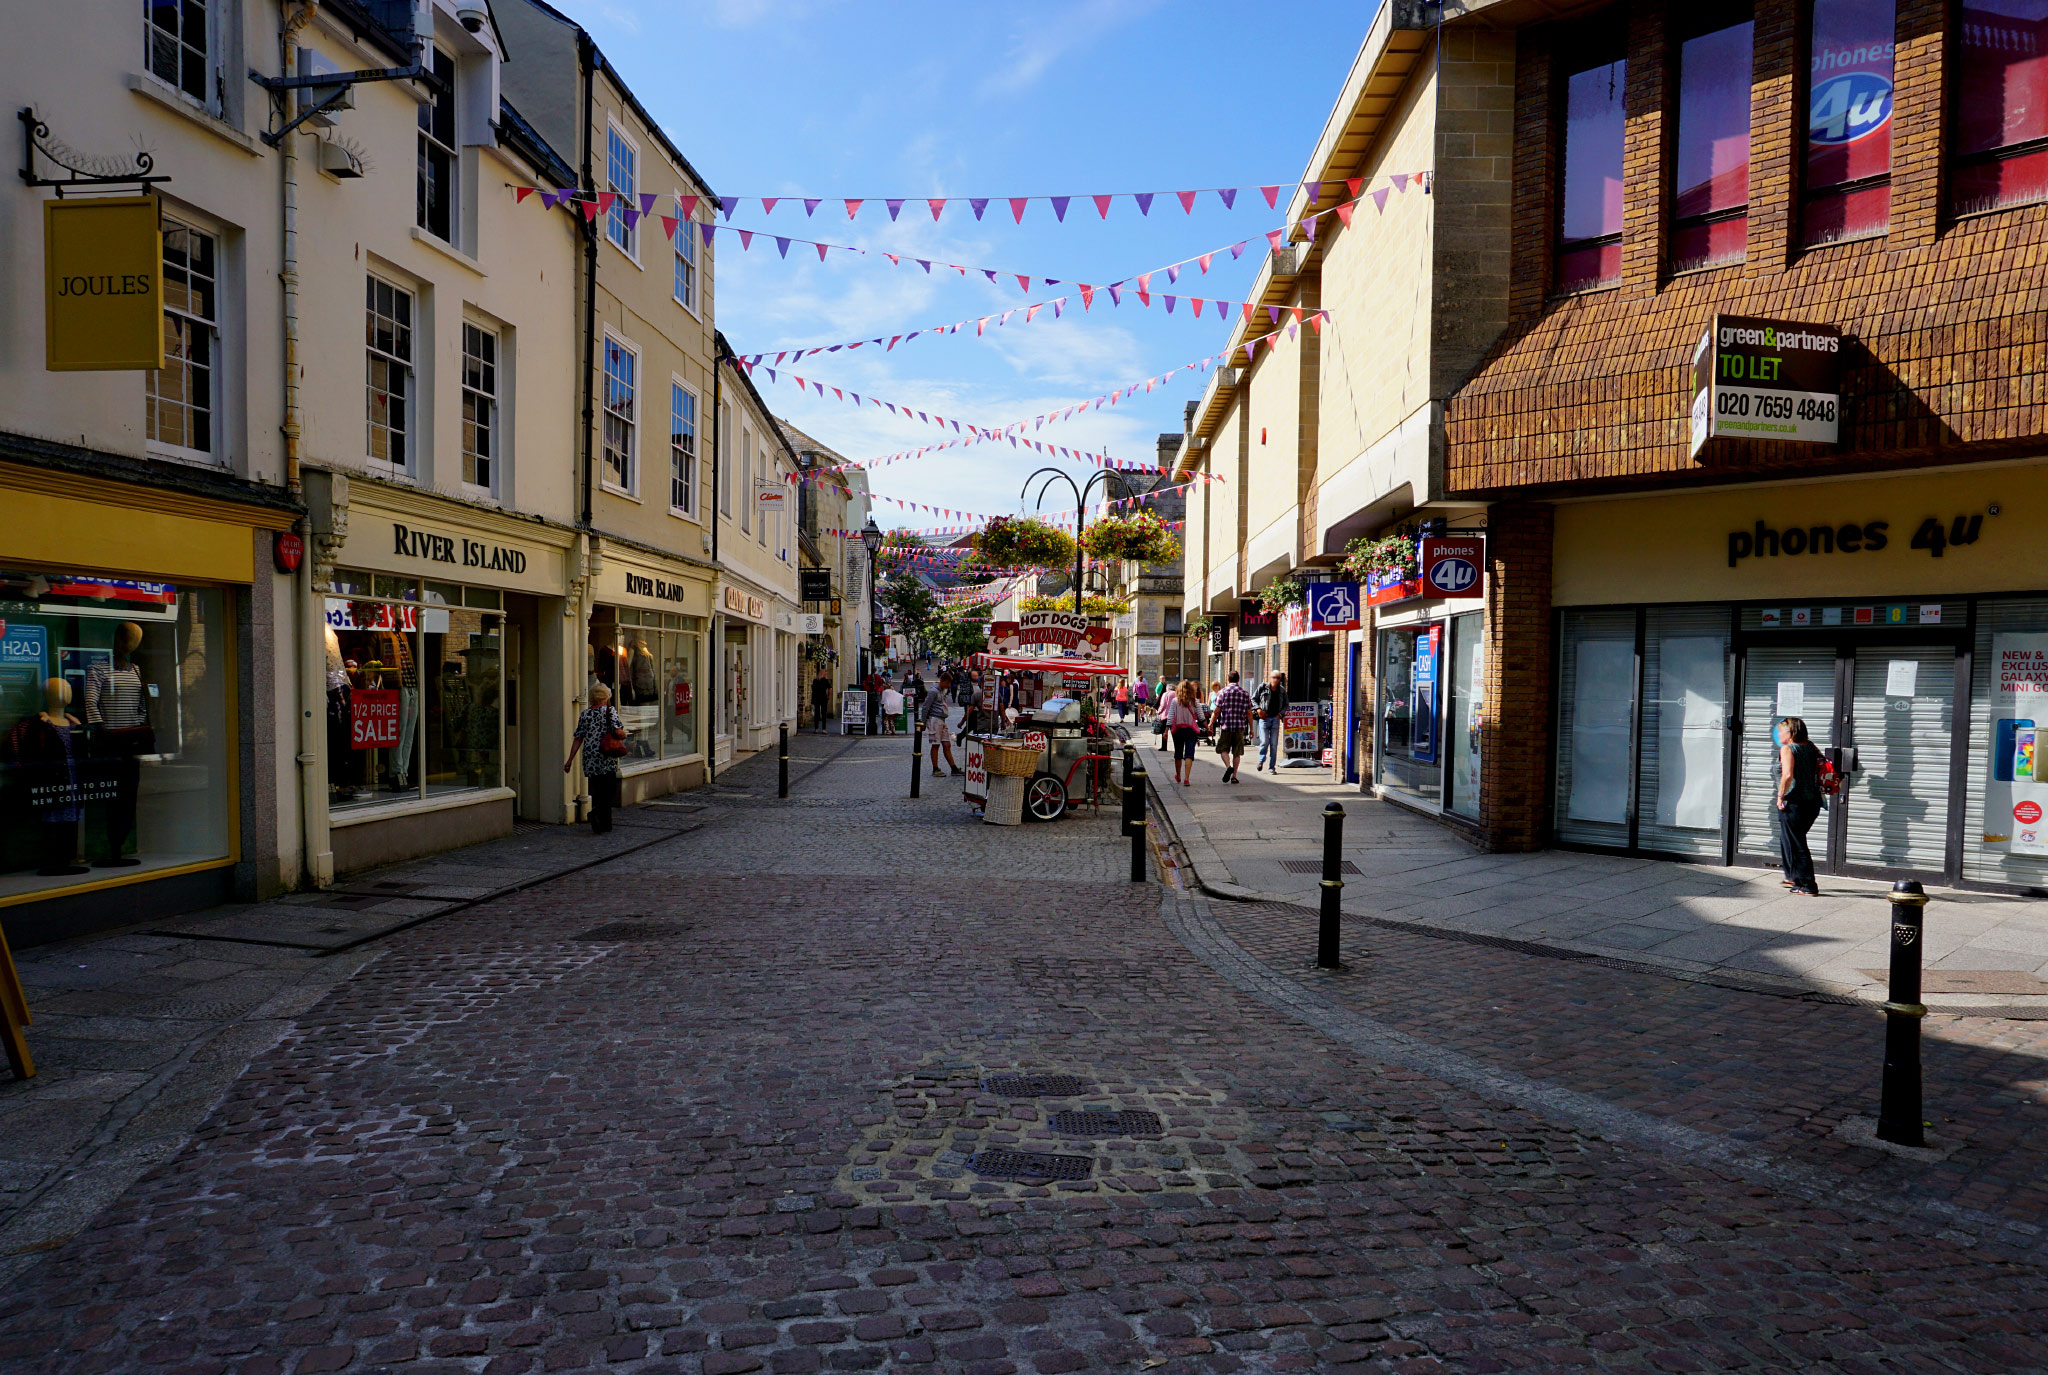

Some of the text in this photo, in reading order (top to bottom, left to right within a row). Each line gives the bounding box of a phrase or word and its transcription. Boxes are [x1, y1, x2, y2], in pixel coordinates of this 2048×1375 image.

[1810, 80, 1889, 139] 4u
[58, 274, 149, 296] JOULES
[1720, 326, 1839, 353] green&partners
[1719, 354, 1783, 381] TO LET
[1717, 392, 1750, 416] 020
[1754, 395, 1793, 419] 7659
[1796, 398, 1835, 422] 4848
[1717, 419, 1797, 433] greenandpartners.co.uk
[1728, 514, 1984, 568] phones 4u
[1433, 545, 1475, 558] phones
[1434, 560, 1473, 590] 4u
[1020, 613, 1087, 630] HOT DOGS
[1244, 611, 1273, 625] hmv
[1213, 625, 1223, 651] next
[1418, 654, 1432, 671] CASH
[2002, 650, 2045, 660] NEW &
[2001, 661, 2048, 671] EXCLUS
[2000, 683, 2029, 692] MINI
[353, 703, 397, 718] 1/2 PRICE
[354, 719, 397, 743] SALE
[1286, 718, 1314, 728] SALE
[1025, 732, 1046, 743] HOT
[968, 769, 985, 785] DOGS
[31, 783, 78, 794] WELCOME
[99, 780, 118, 788] OUR
[32, 791, 117, 806] NEW COLLECTION
